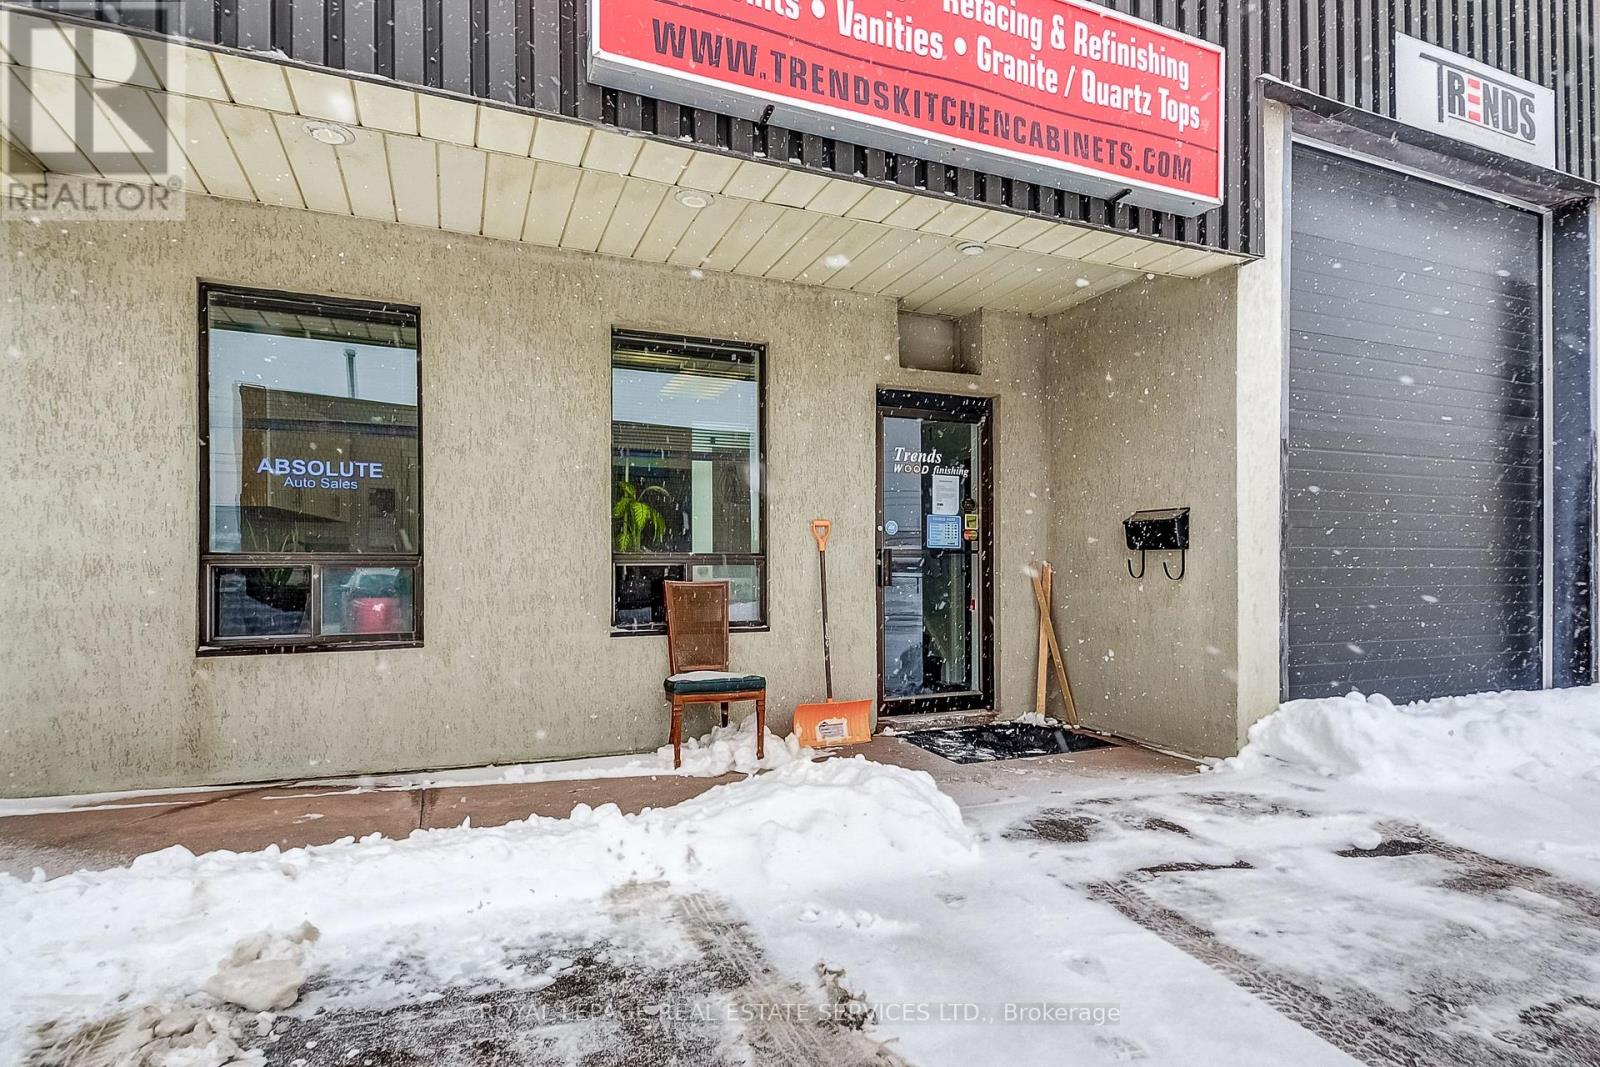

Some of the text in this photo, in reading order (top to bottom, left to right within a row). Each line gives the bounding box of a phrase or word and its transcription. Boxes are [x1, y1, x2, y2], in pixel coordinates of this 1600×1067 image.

[836, 0, 944, 60] Vanities
[976, 35, 1059, 95] Granite
[1064, 65, 1077, 98] /
[1081, 68, 1152, 117] Quartz
[1158, 87, 1200, 132] Tops
[1050, 14, 1067, 50] &
[1073, 20, 1190, 91] Refinishing
[652, 18, 1192, 184] WWW.TRENDSKITCHENCABINETS.COM
[1419, 52, 1536, 141] TRENDS
[256, 457, 384, 478] ABSOLUTE
[893, 447, 943, 464] Trends
[894, 463, 970, 479] WOOD finishing
[283, 476, 359, 490] Auto Sales
